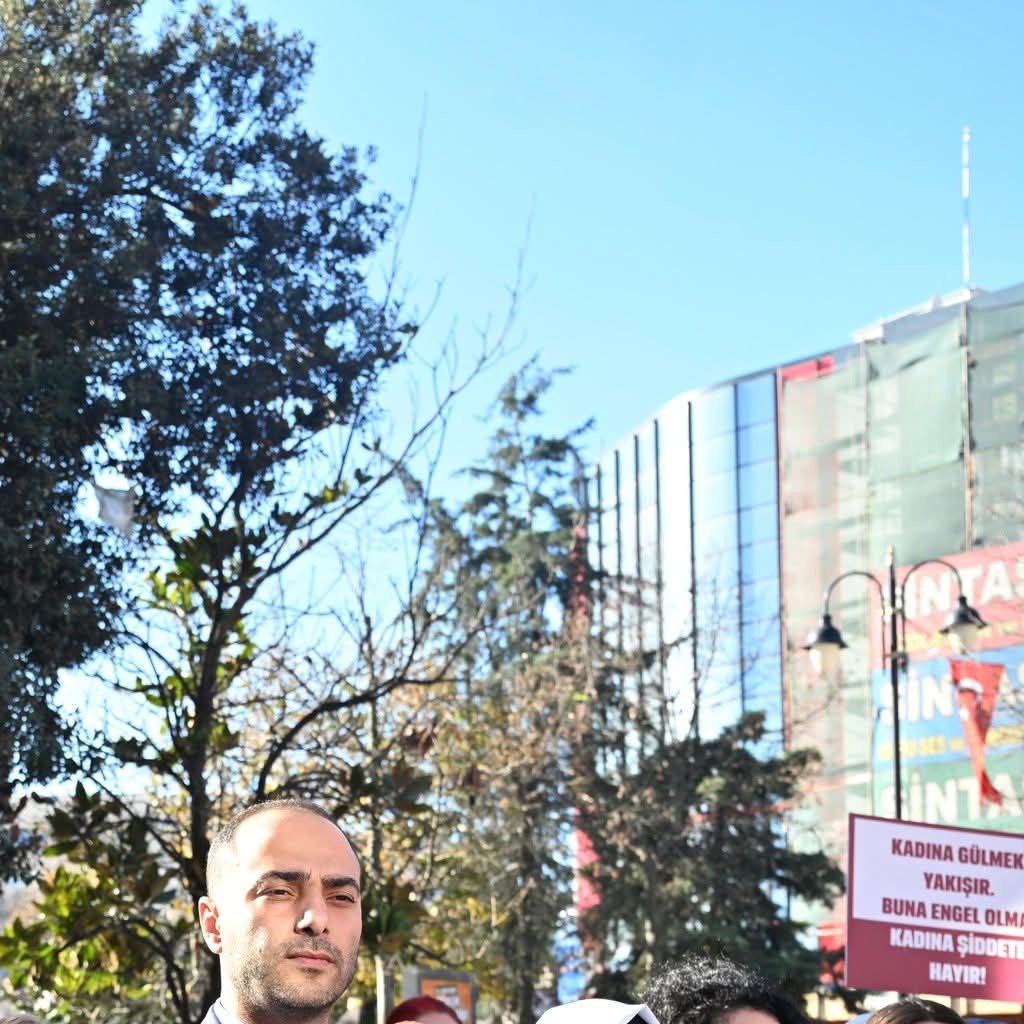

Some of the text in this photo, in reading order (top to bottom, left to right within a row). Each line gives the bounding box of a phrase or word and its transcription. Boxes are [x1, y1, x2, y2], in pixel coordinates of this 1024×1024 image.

[891, 838, 1024, 870] KADINA GÜLMEK
[923, 872, 995, 898] YAKIŞIR.
[882, 897, 927, 919] BUNA
[931, 903, 981, 924] ENGEL
[890, 928, 954, 952] KADINA
[929, 962, 987, 985] HAYIR!
